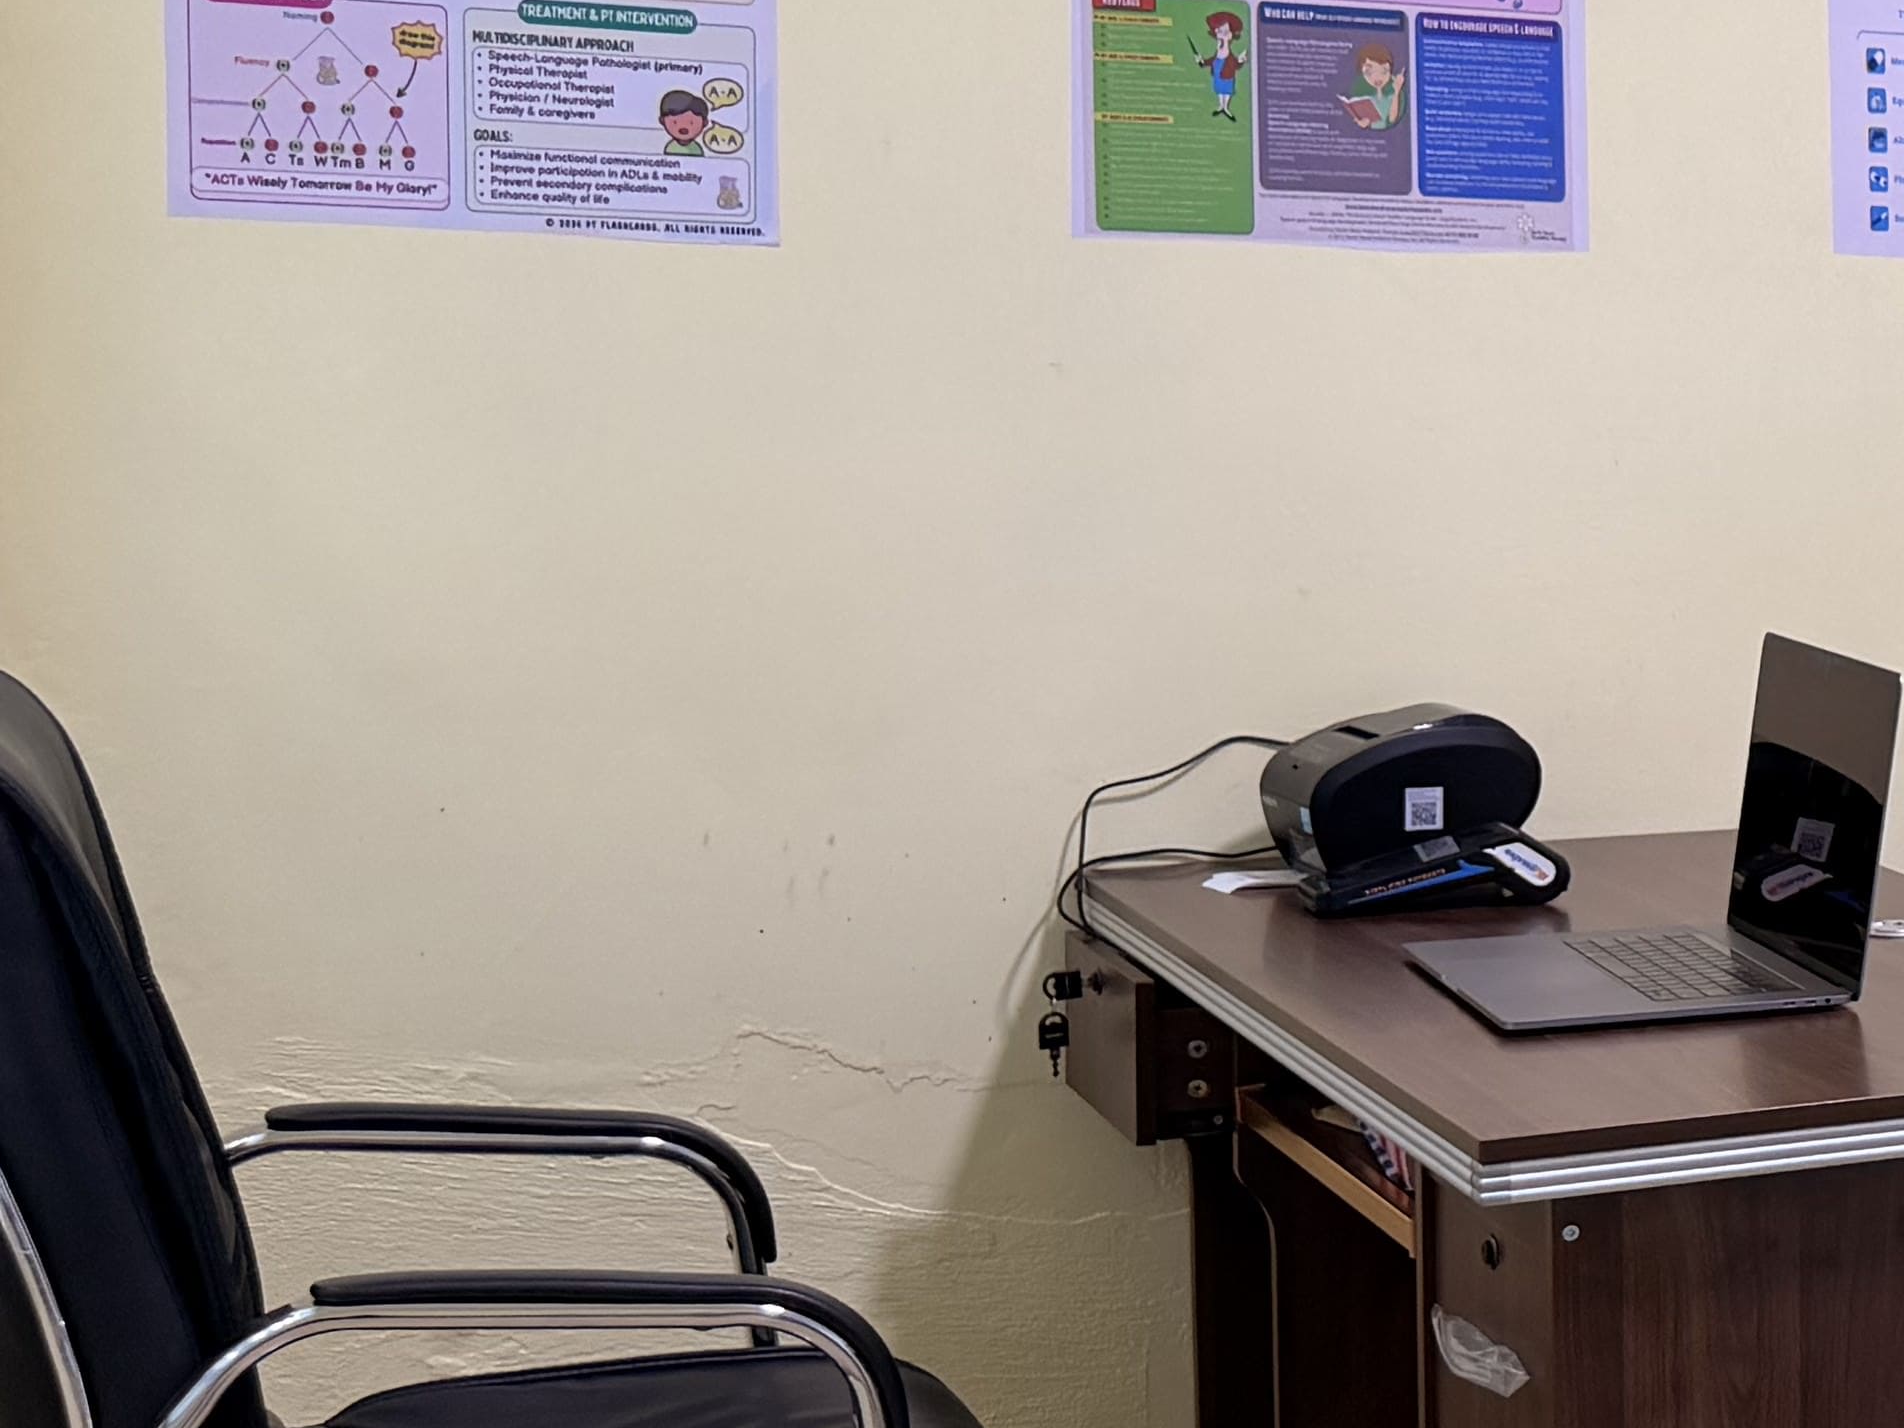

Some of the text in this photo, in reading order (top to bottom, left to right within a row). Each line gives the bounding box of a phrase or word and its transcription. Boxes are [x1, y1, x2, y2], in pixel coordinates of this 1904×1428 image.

[521, 4, 694, 28] TREATMENT & PT INTERVENTION
[472, 30, 634, 53] MULTIDISCIPLINARY APPROACH
[488, 51, 703, 75] Speech-Language Pathologist (primary)
[473, 129, 513, 143] GOALS:
[490, 189, 610, 206] Enhance quality of life
